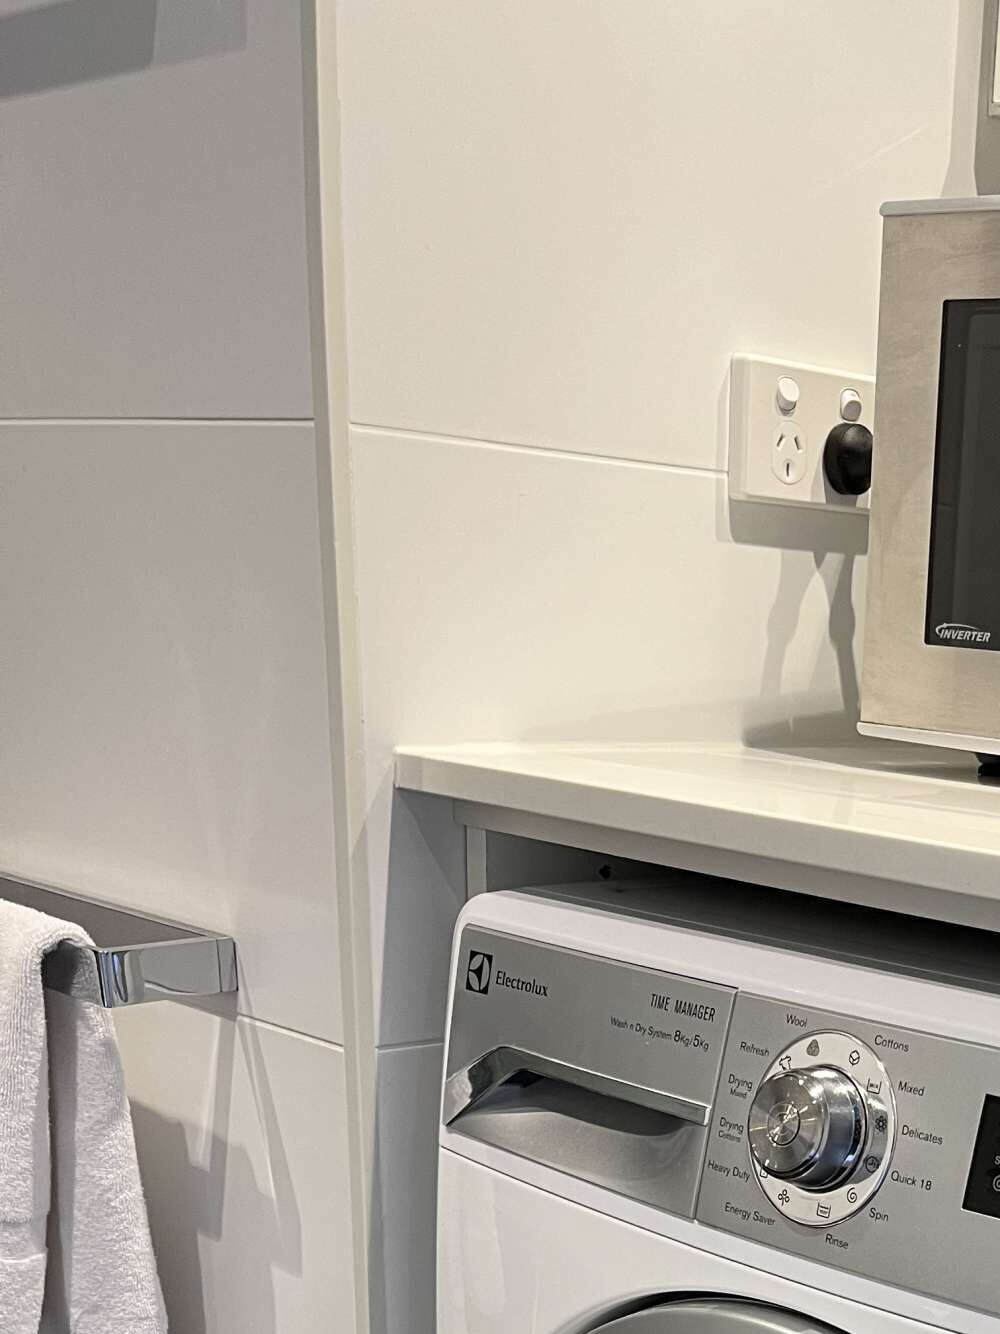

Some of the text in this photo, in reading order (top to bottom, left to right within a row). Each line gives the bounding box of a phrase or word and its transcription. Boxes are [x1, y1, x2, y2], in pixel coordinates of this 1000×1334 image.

[940, 629, 990, 642] INVERTER
[495, 970, 549, 997] Electrolux
[650, 993, 715, 1022] TIME MANAGER
[610, 1015, 628, 1029] Wash
[635, 1023, 647, 1035] Dry
[648, 1026, 672, 1040] System
[786, 1014, 807, 1028] Wool
[740, 1041, 770, 1057] Refresh
[874, 1035, 909, 1053] Cottons
[728, 1073, 753, 1092] Drying
[898, 1081, 925, 1096] Mixed
[719, 1117, 744, 1134] Drying
[901, 1125, 943, 1146] Delicates
[708, 1160, 750, 1182] Heavy Duty
[891, 1170, 932, 1191] Quick 18
[724, 1202, 776, 1226] Energy Saver
[868, 1207, 889, 1222] Spin
[825, 1233, 849, 1249] Rinse
